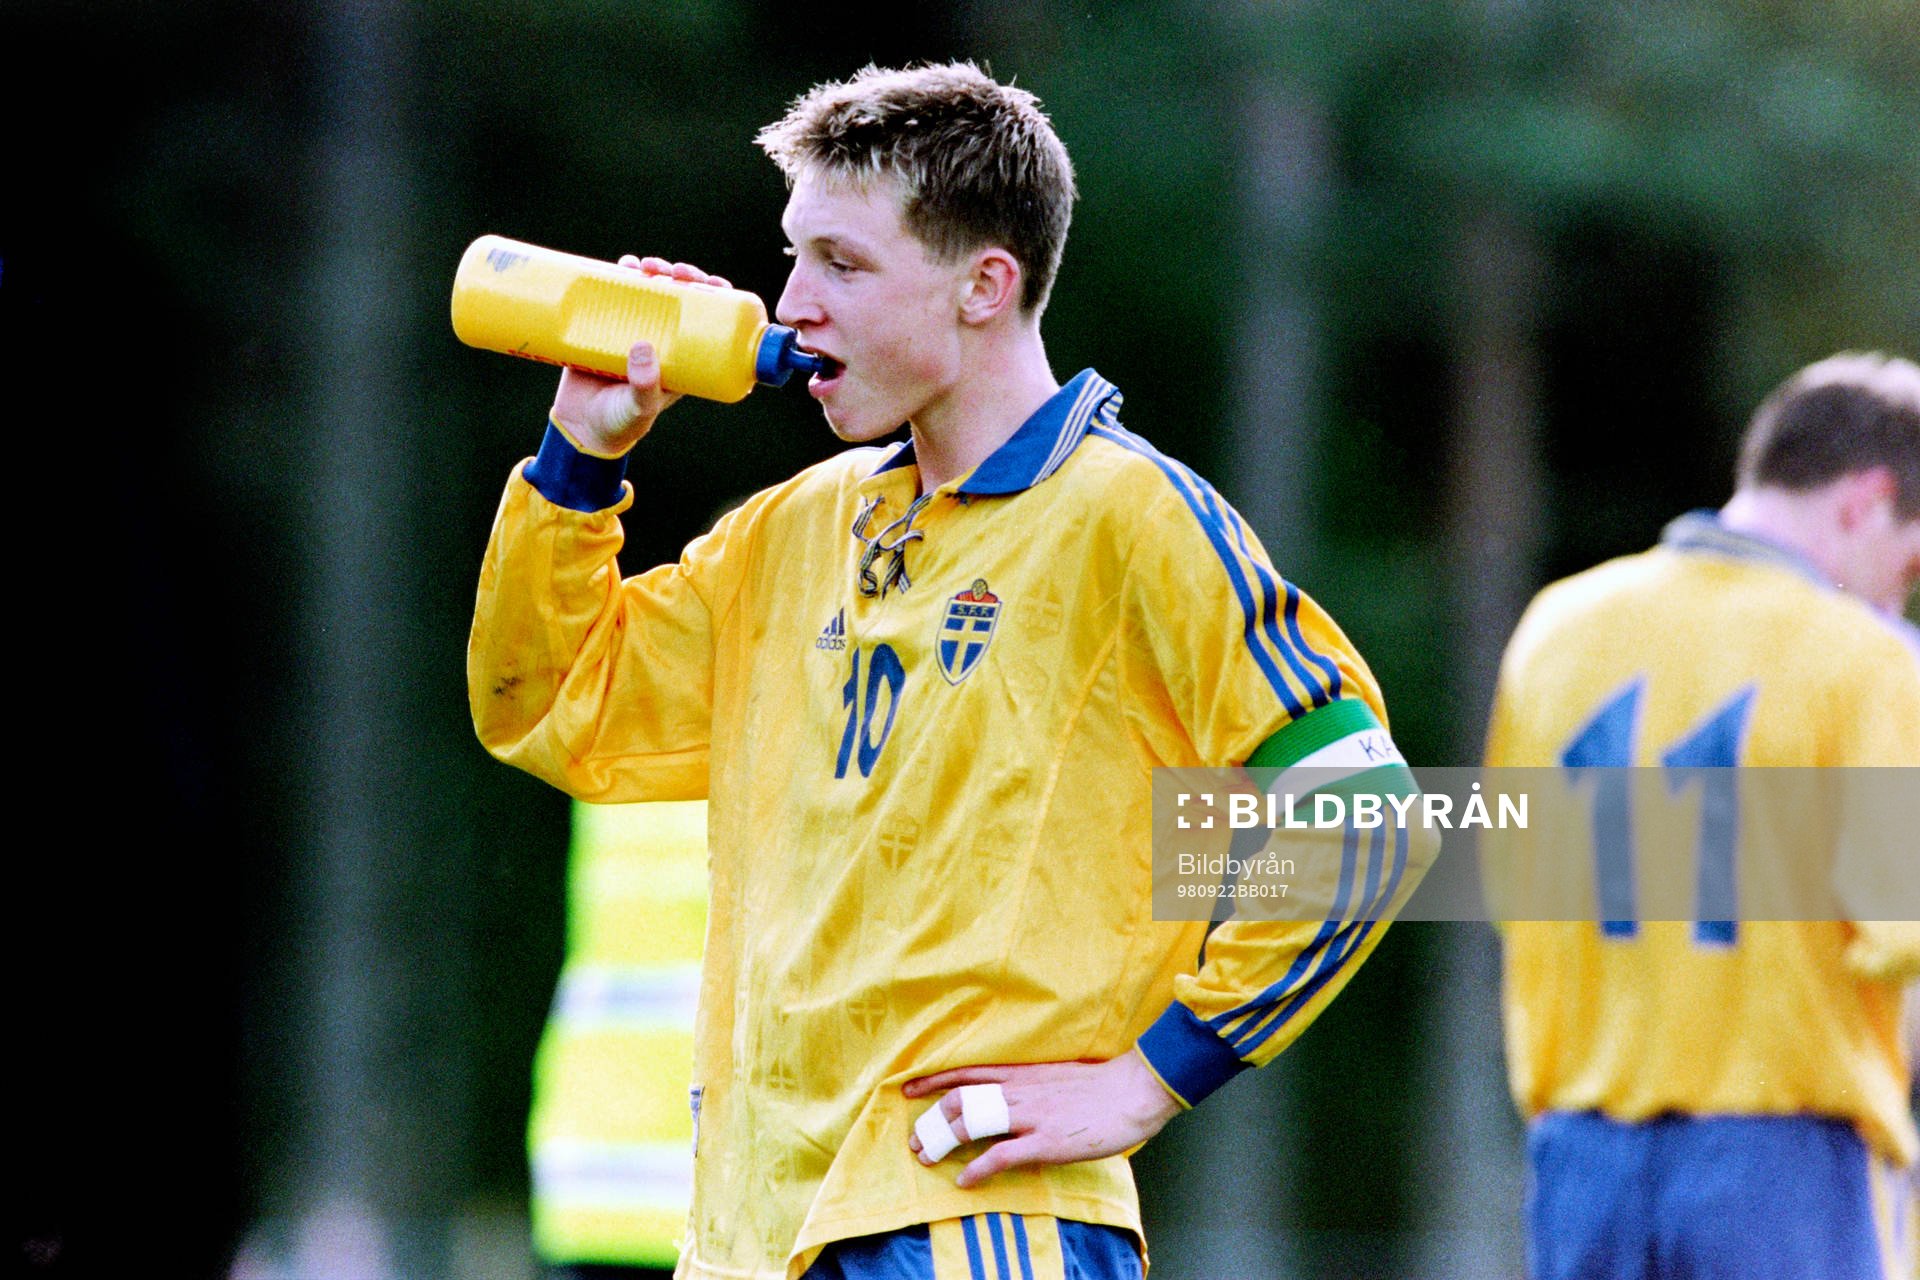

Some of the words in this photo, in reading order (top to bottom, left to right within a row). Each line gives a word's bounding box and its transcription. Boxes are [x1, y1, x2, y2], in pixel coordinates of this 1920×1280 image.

[815, 633, 846, 650] adidas
[834, 643, 906, 779] 10
[1561, 671, 1756, 947] 11
